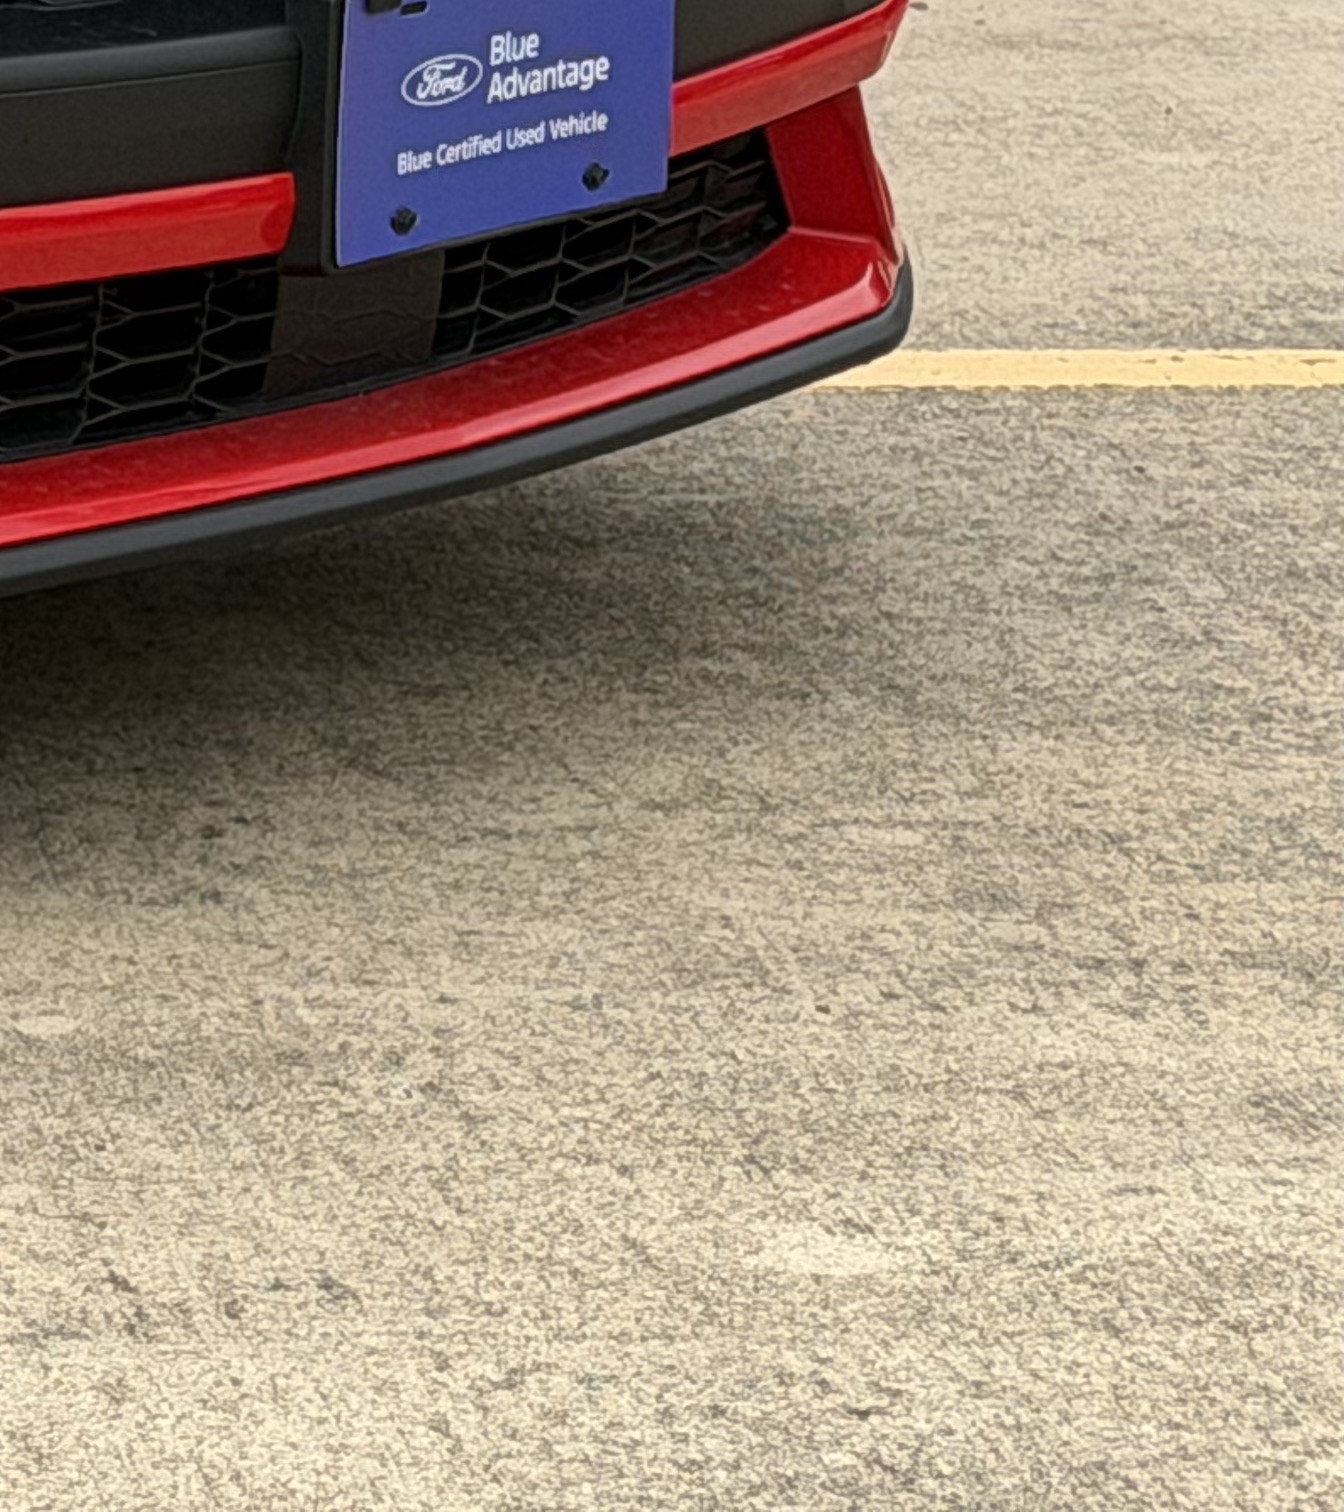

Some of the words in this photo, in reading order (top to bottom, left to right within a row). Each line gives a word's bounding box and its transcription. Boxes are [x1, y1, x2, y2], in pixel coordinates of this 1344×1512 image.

[488, 30, 540, 67] Blue
[416, 61, 468, 100] Ford
[486, 55, 611, 104] Advantage
[397, 150, 433, 176] Blue
[436, 130, 502, 167] Certified
[506, 120, 546, 150] Used
[549, 109, 610, 141] Vehicle
